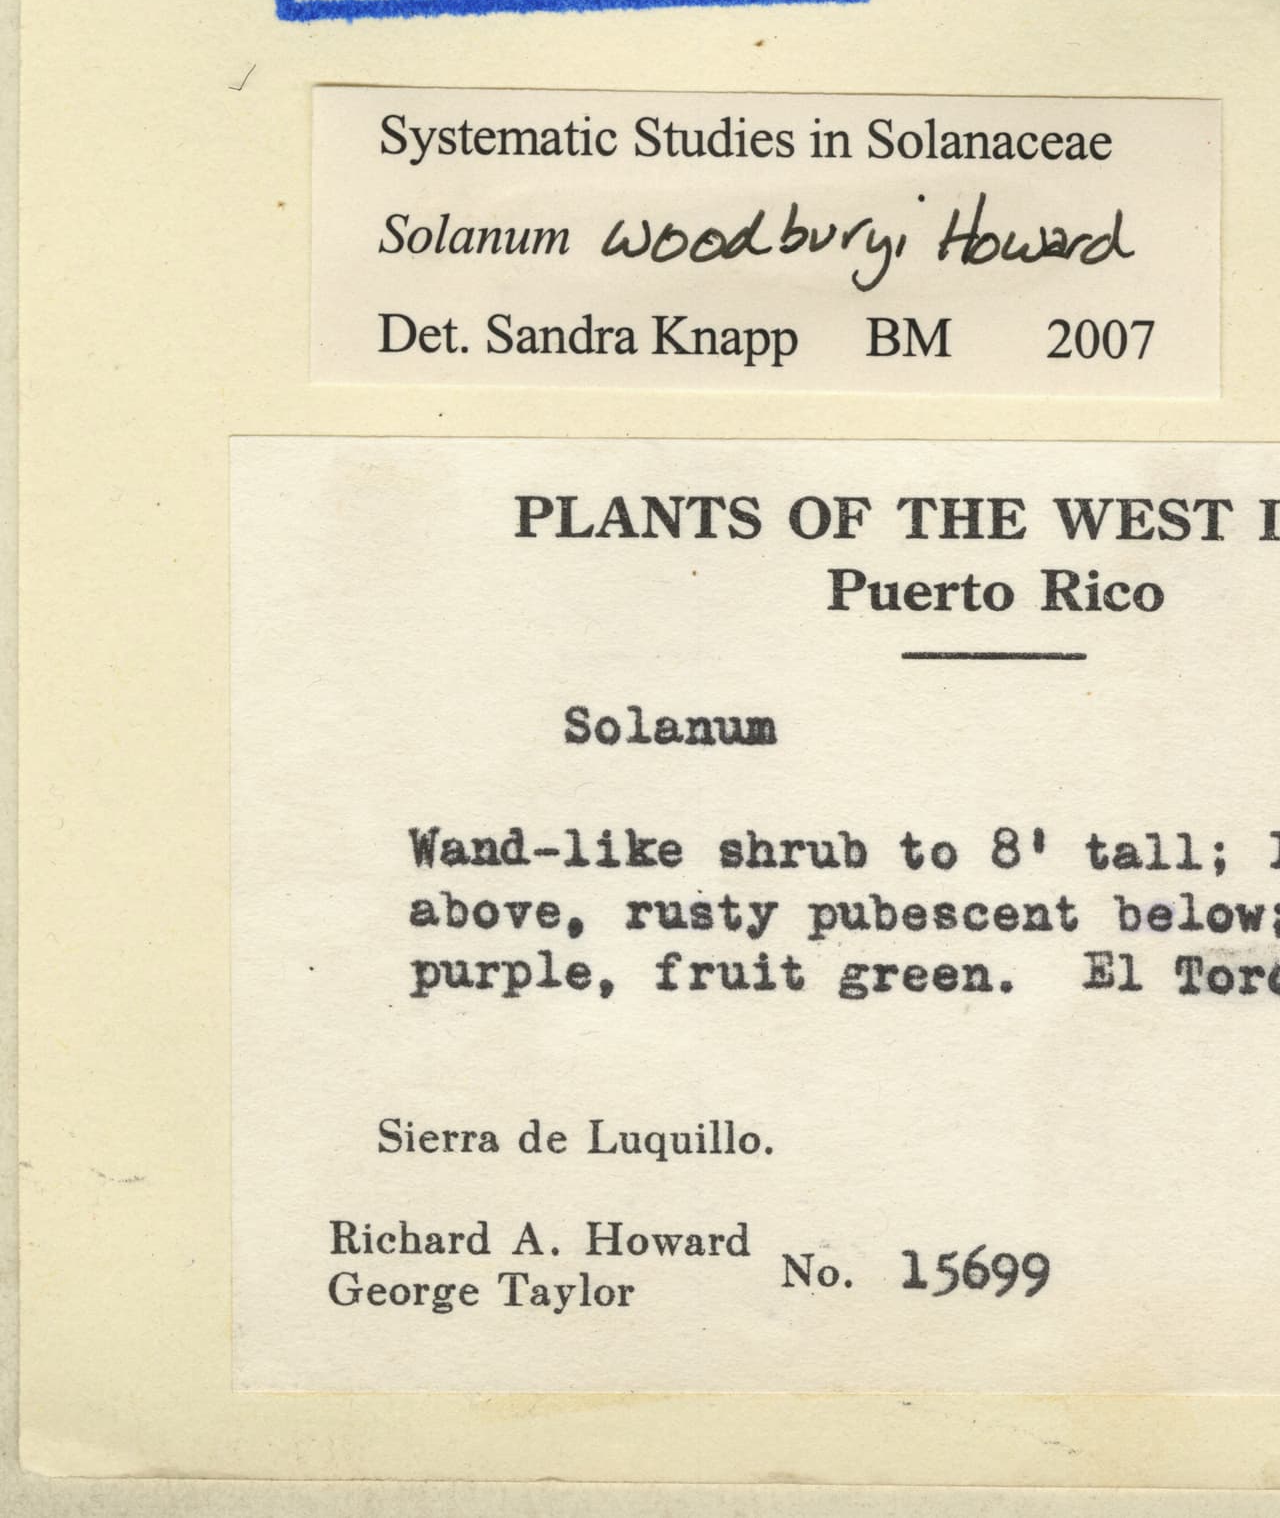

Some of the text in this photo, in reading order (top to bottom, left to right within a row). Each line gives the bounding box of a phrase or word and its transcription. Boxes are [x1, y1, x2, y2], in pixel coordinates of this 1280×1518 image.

[380, 113, 1113, 167] Systematic Studies in Solanaceae
[378, 212, 570, 256] Solanum
[600, 191, 1136, 293] woodburyi Howard
[377, 312, 1156, 368] Det. Sandra Knapp BM 2007
[514, 495, 762, 540] PLANTS
[788, 495, 873, 541] OF
[896, 497, 1027, 540] THE
[1052, 497, 1234, 542] WEST
[826, 567, 1165, 613] Puerto Rico
[563, 704, 779, 747] Solanum
[407, 825, 684, 870] Wand-like
[718, 829, 868, 870] shrub
[898, 830, 959, 872] to
[990, 826, 1046, 870] 8'
[1084, 831, 1227, 878] tall;
[408, 890, 585, 940] above,
[625, 893, 780, 941] rusty
[807, 892, 1079, 942] pubescent
[408, 948, 615, 1000] purple,
[655, 950, 806, 992] fruit
[837, 962, 1014, 1001] green.
[1081, 949, 1144, 993] El
[377, 1117, 774, 1163] Sierra de Luquillo.
[329, 1219, 752, 1258] Richard A. Howard
[327, 1271, 636, 1315] George Taylor
[780, 1243, 1051, 1298] No. 15699
